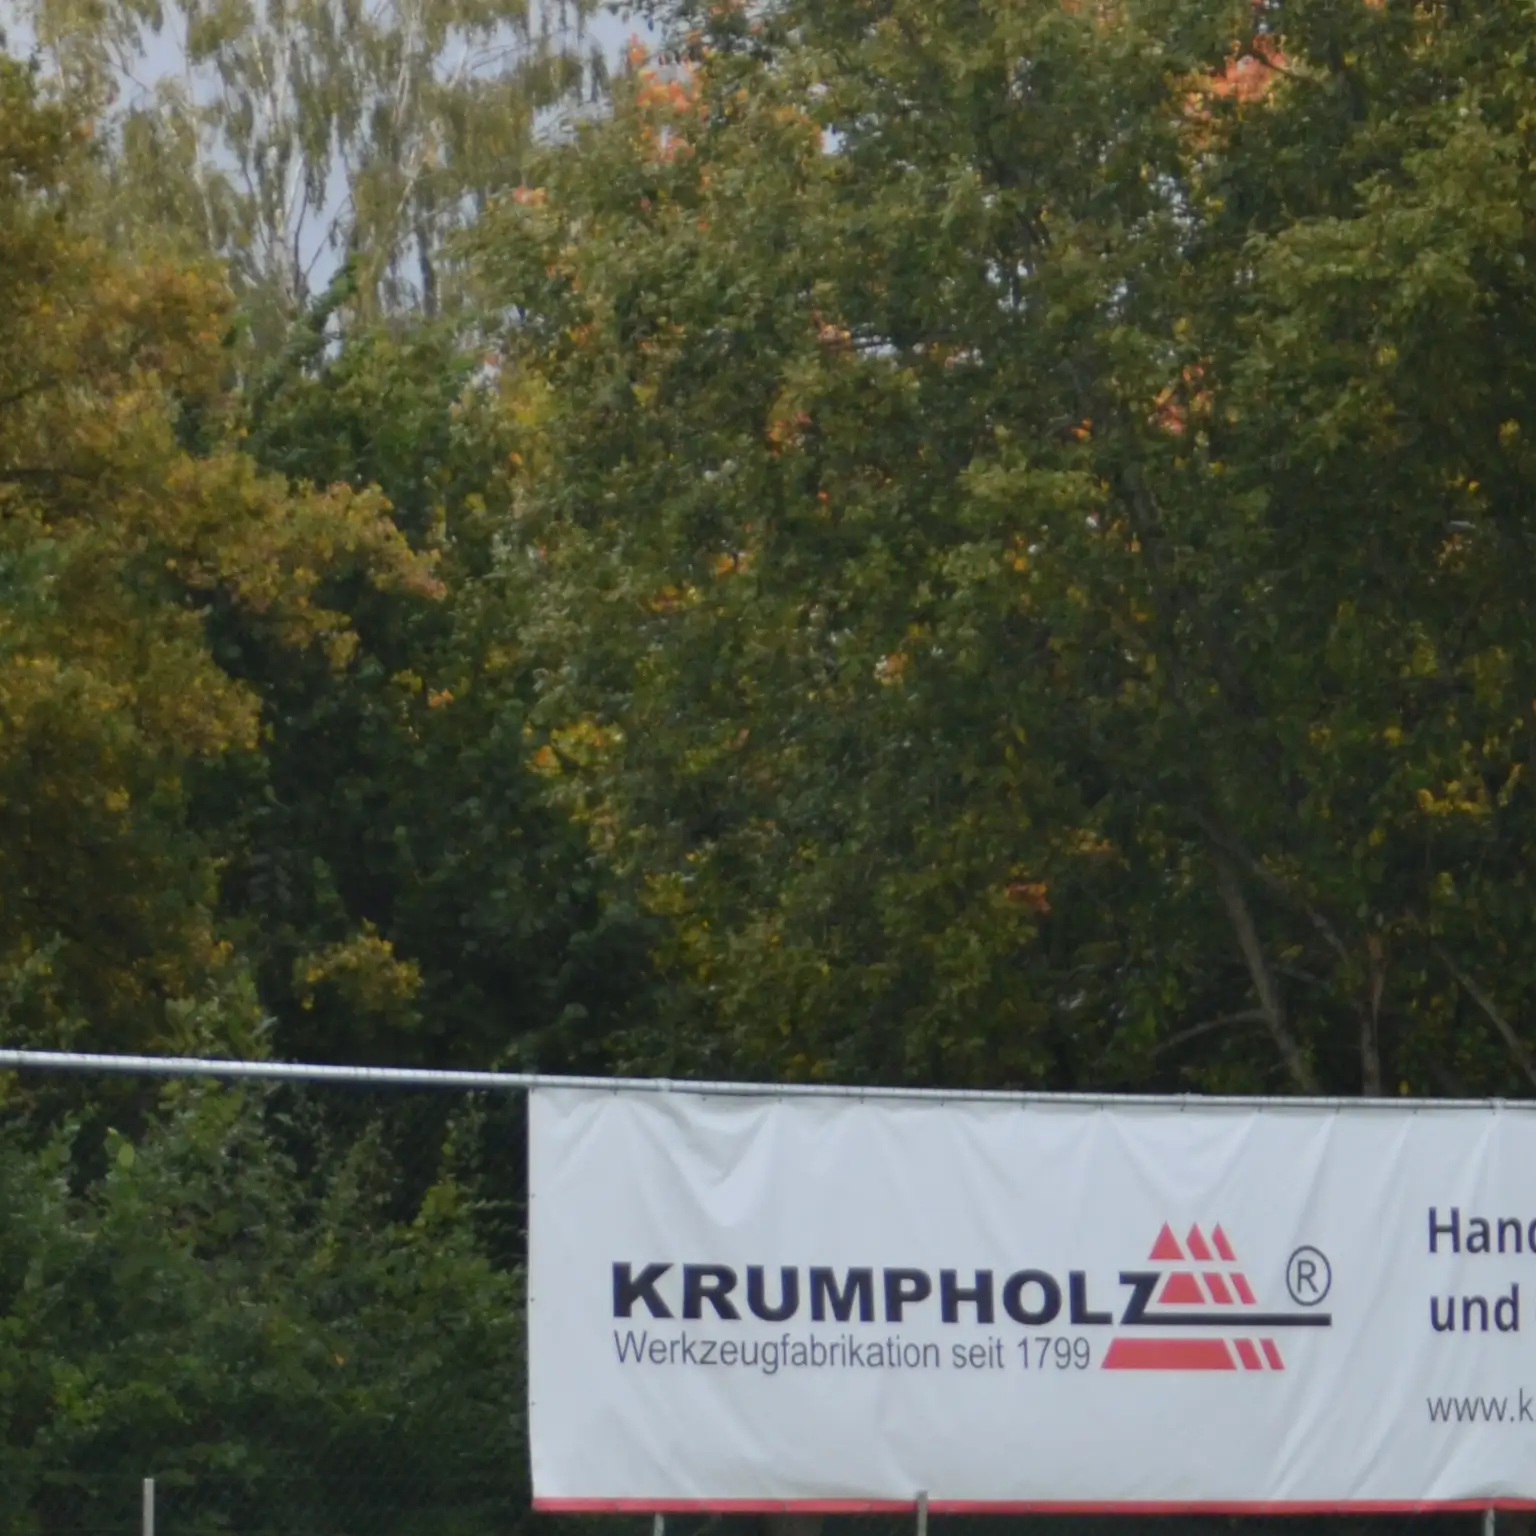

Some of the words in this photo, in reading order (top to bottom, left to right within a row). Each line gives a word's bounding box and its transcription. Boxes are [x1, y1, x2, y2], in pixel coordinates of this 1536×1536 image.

[610, 1260, 1332, 1327] KRUMPHOLZ
[1428, 1282, 1520, 1334] und
[613, 1328, 942, 1375] Werkzeugfabrikation
[951, 1336, 1005, 1371] seit
[1016, 1335, 1091, 1371] 1799
